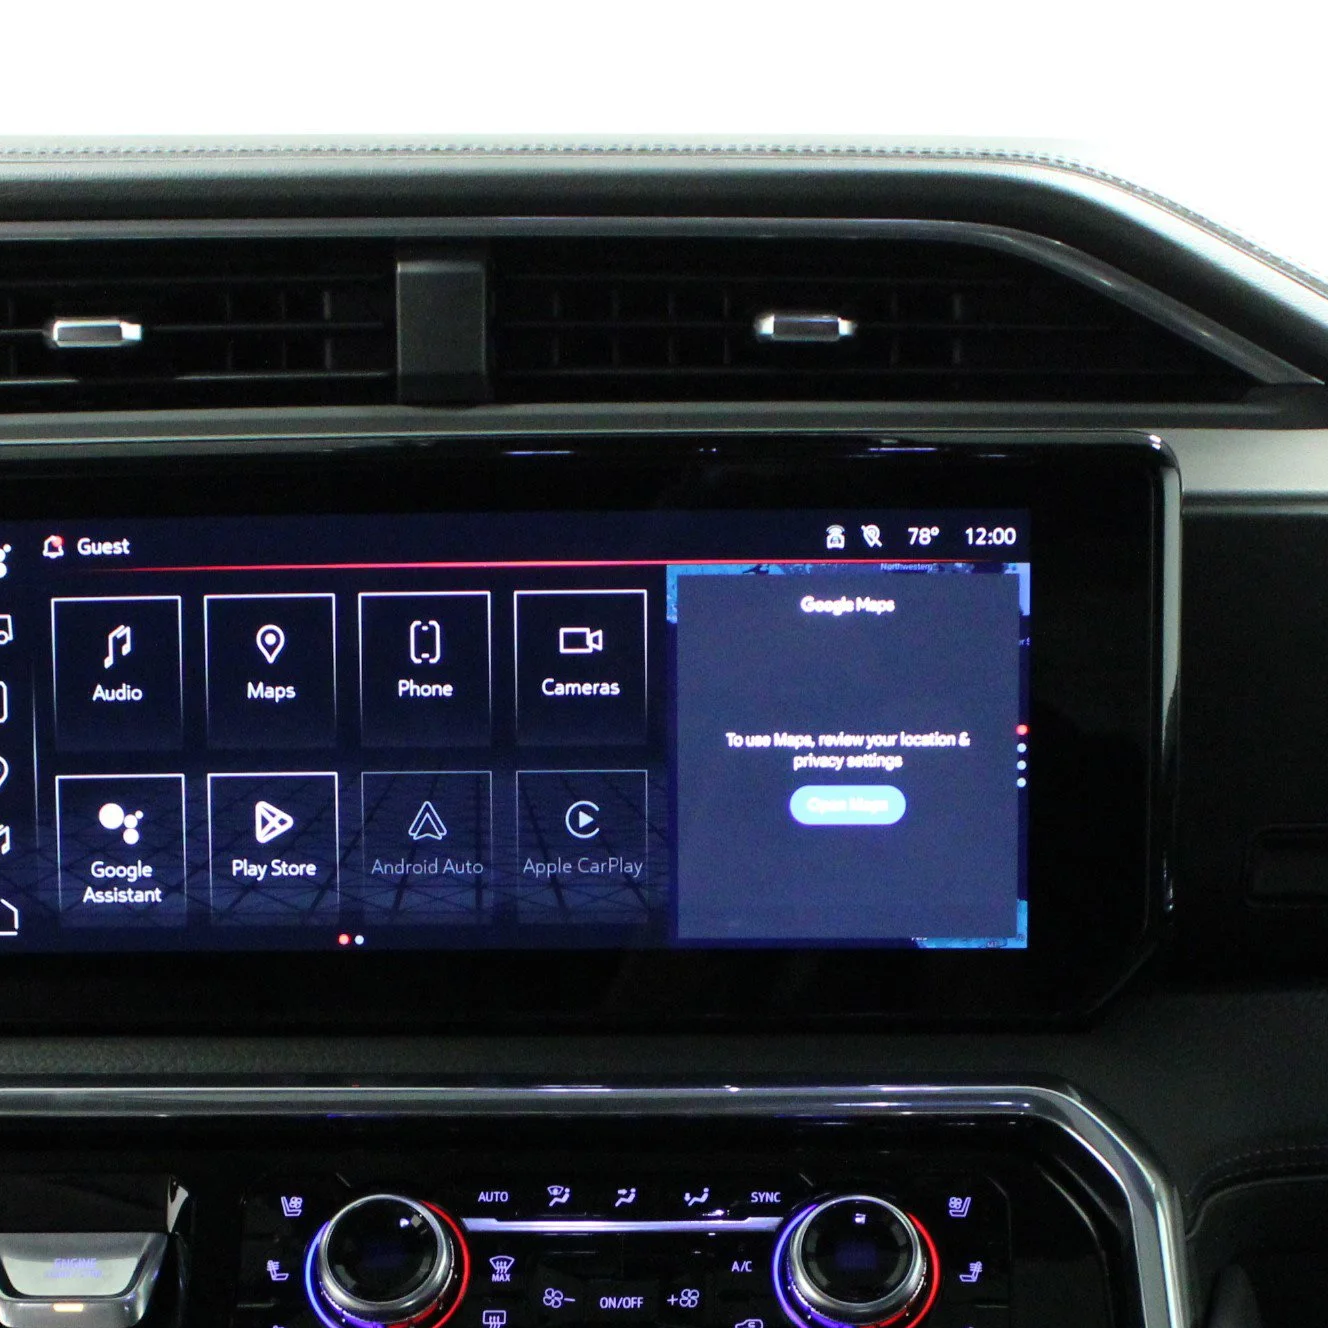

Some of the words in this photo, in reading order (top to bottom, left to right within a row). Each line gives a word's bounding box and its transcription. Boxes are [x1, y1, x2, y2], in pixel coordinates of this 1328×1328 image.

[907, 526, 940, 545] 78°
[965, 526, 1017, 545] 12:00
[77, 538, 130, 555] Guest
[800, 595, 854, 615] Google
[856, 597, 895, 615] Maps
[92, 683, 143, 701] Audio
[247, 681, 296, 703] Maps
[398, 679, 454, 697] Phone
[541, 677, 620, 696] Cameras
[726, 732, 744, 747] To
[745, 735, 771, 747] use
[773, 732, 815, 750] Maps,
[818, 731, 865, 747] review
[865, 734, 898, 750] your
[900, 731, 956, 747] location
[958, 732, 971, 747] &
[793, 752, 845, 771] privacy
[846, 753, 903, 772] settings
[90, 860, 153, 882] Google
[232, 859, 267, 881] Play
[270, 859, 317, 876] Store
[372, 859, 438, 875] Android
[442, 859, 484, 875] Auto
[523, 858, 572, 878] Apple
[577, 857, 643, 878] CarPlay
[82, 886, 162, 904] Assistant
[478, 1191, 509, 1202] AUTO
[751, 1191, 781, 1203] SYNC
[731, 1261, 753, 1272] A/C
[491, 1274, 511, 1282] MAX
[599, 1297, 644, 1309] ON/OFF
